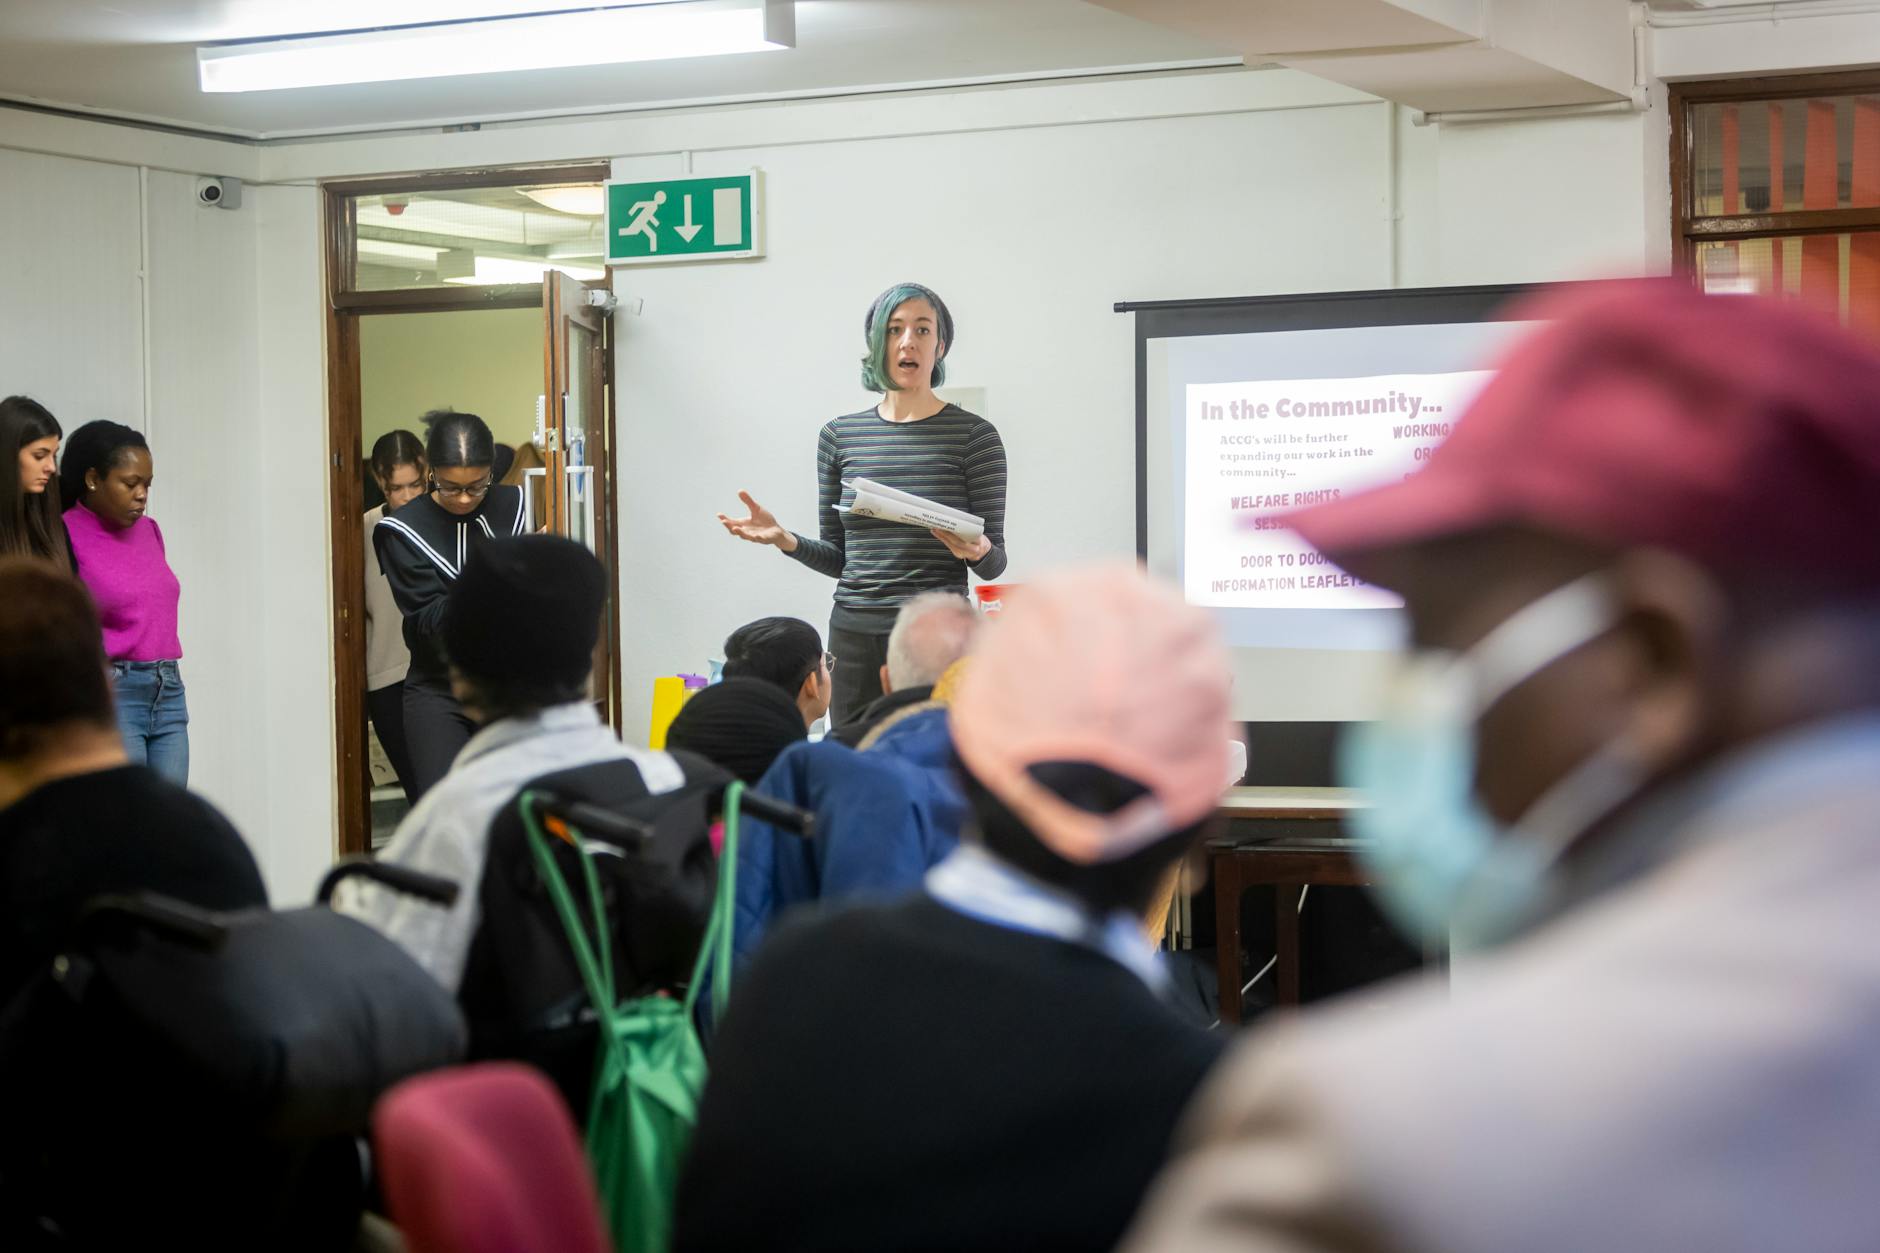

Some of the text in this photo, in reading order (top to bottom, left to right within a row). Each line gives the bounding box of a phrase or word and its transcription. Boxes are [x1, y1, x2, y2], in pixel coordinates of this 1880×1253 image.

[1201, 391, 1442, 420] In the Community...
[1393, 423, 1449, 439] WORKING
[1220, 433, 1348, 445] ACCG's will be further
[1220, 448, 1373, 462] expanding our work in the
[1220, 467, 1296, 478] community...
[1231, 489, 1340, 510] WELFARE RIGHTS
[1241, 555, 1273, 569] DOOR
[1278, 554, 1295, 566] TO
[1212, 578, 1295, 593] INFORMATION
